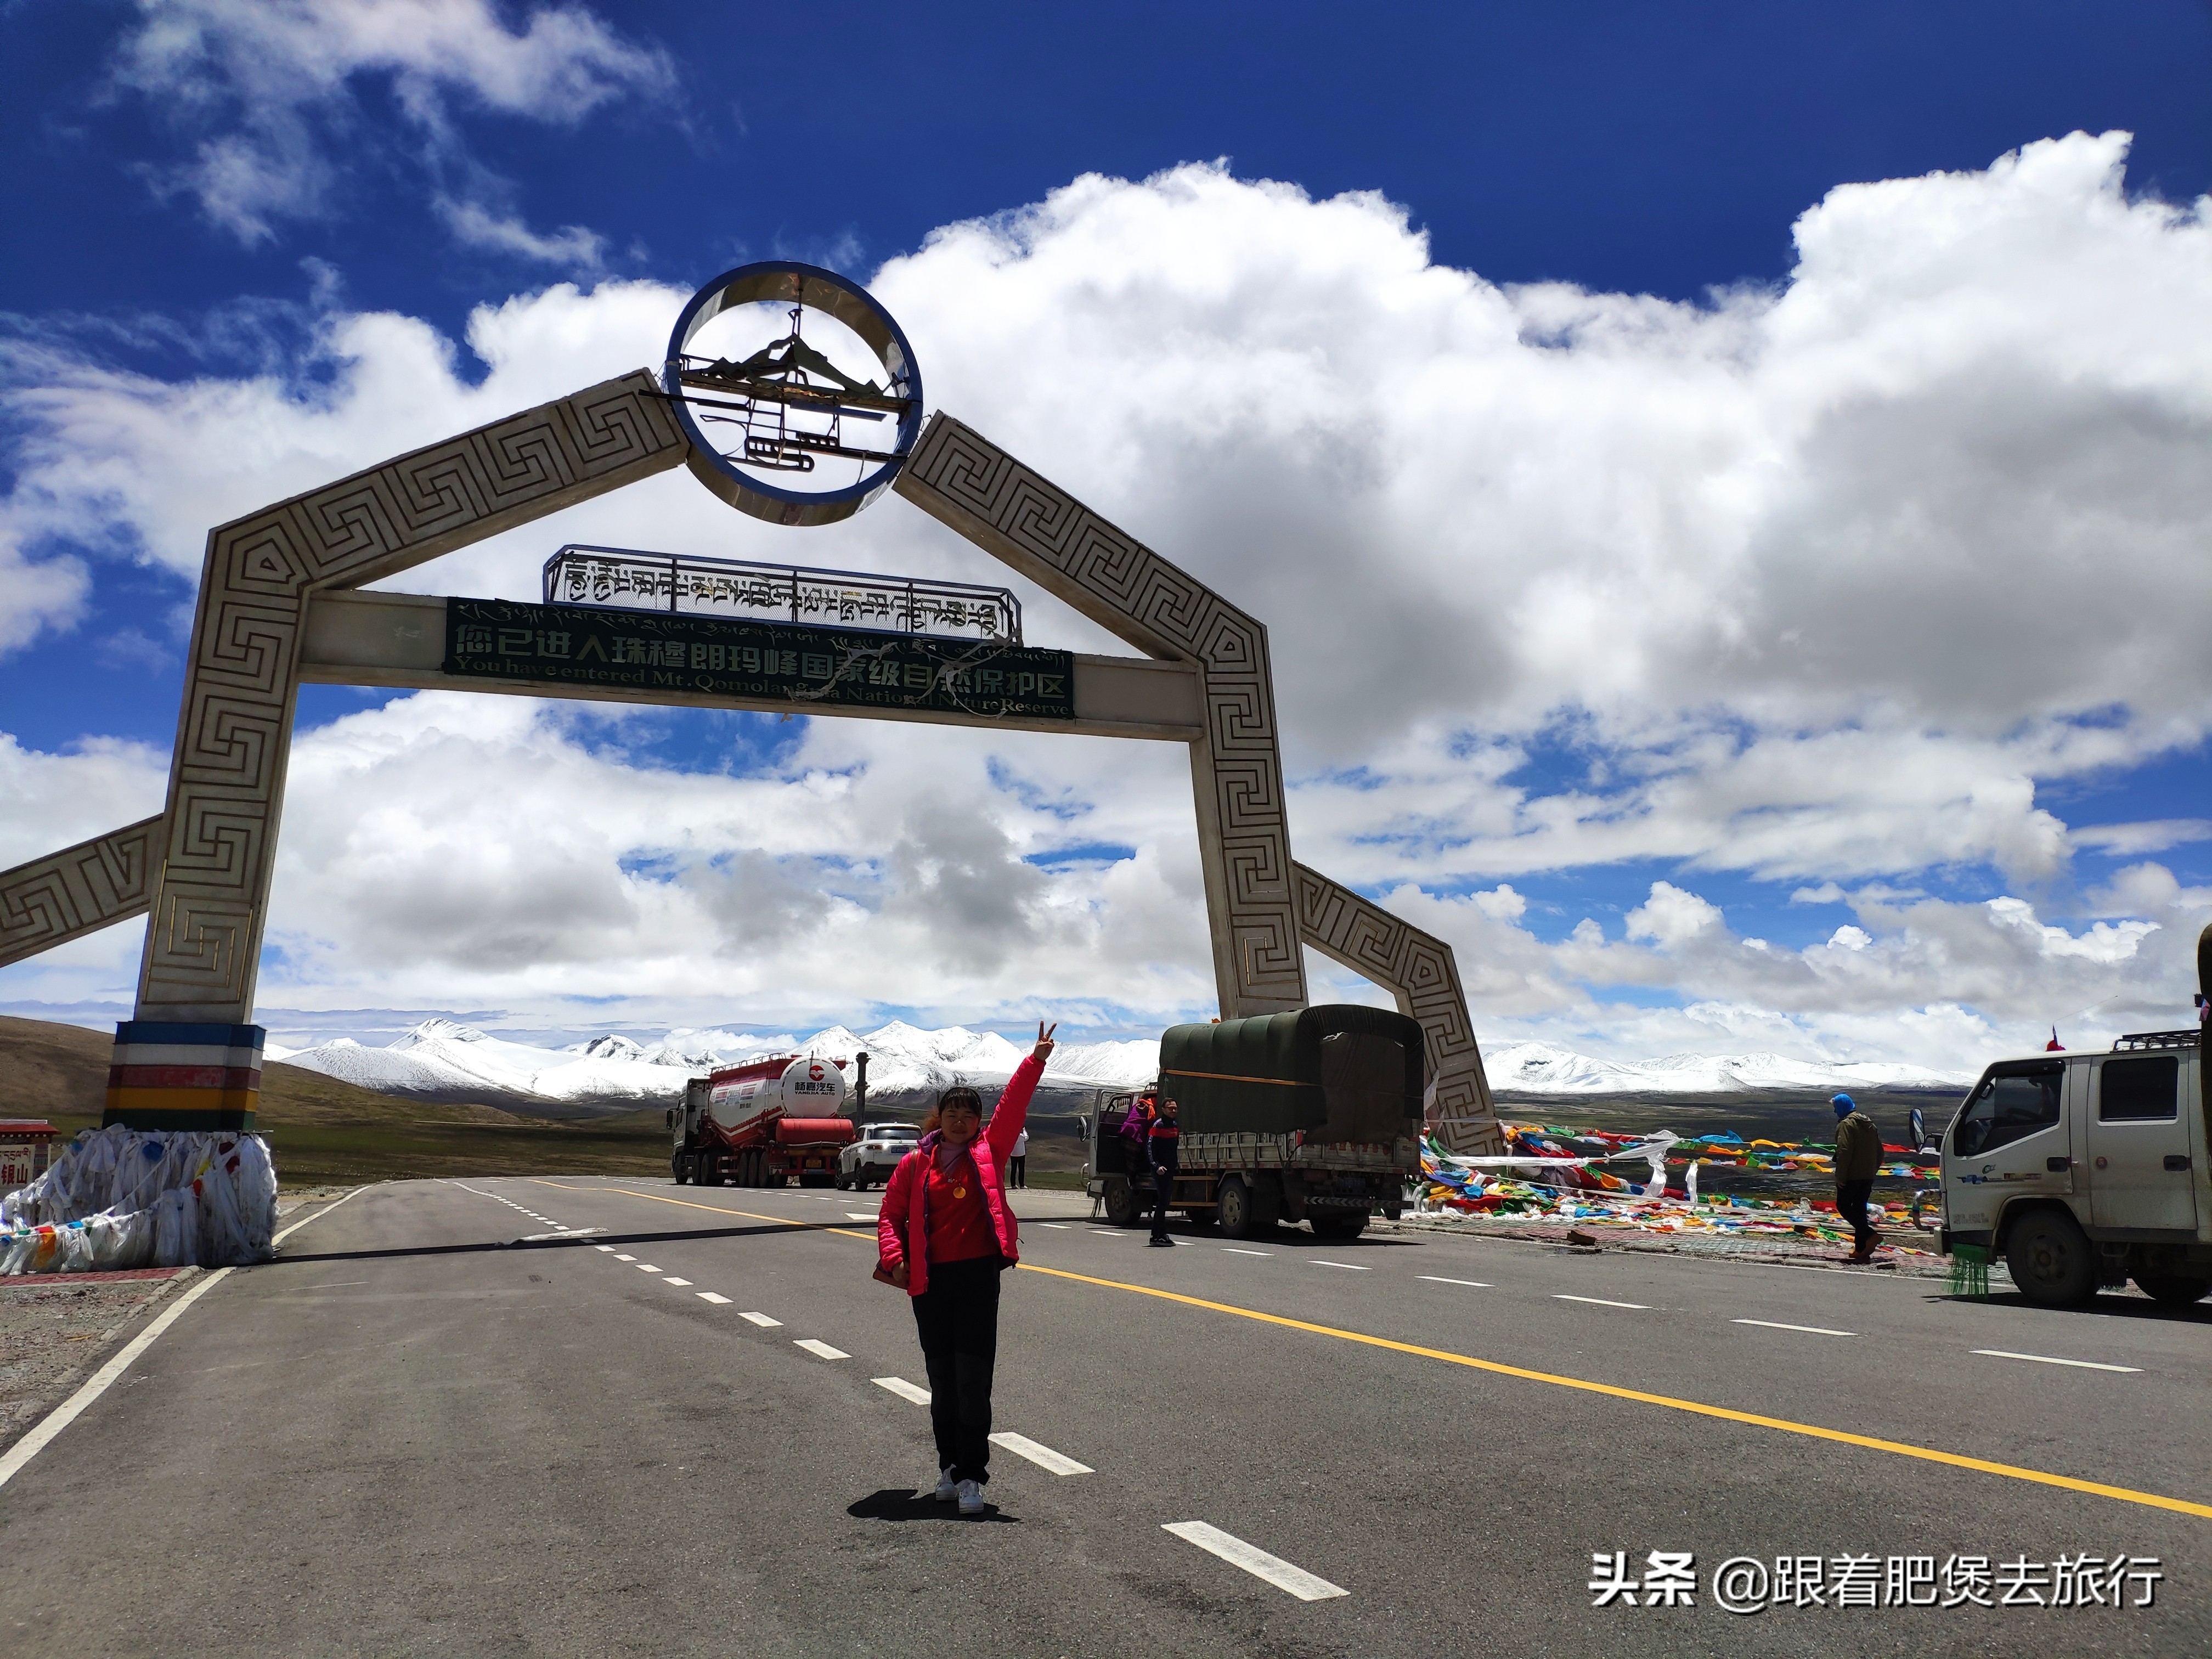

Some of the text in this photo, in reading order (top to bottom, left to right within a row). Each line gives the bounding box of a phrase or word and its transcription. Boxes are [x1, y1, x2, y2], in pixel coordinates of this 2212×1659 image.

[453, 656, 501, 672] You
[505, 658, 557, 676] have
[561, 667, 645, 683] entered
[1000, 698, 1070, 715] Reserve
[794, 1081, 836, 1092] 杨嘉汽车
[1, 1163, 28, 1185] 银山
